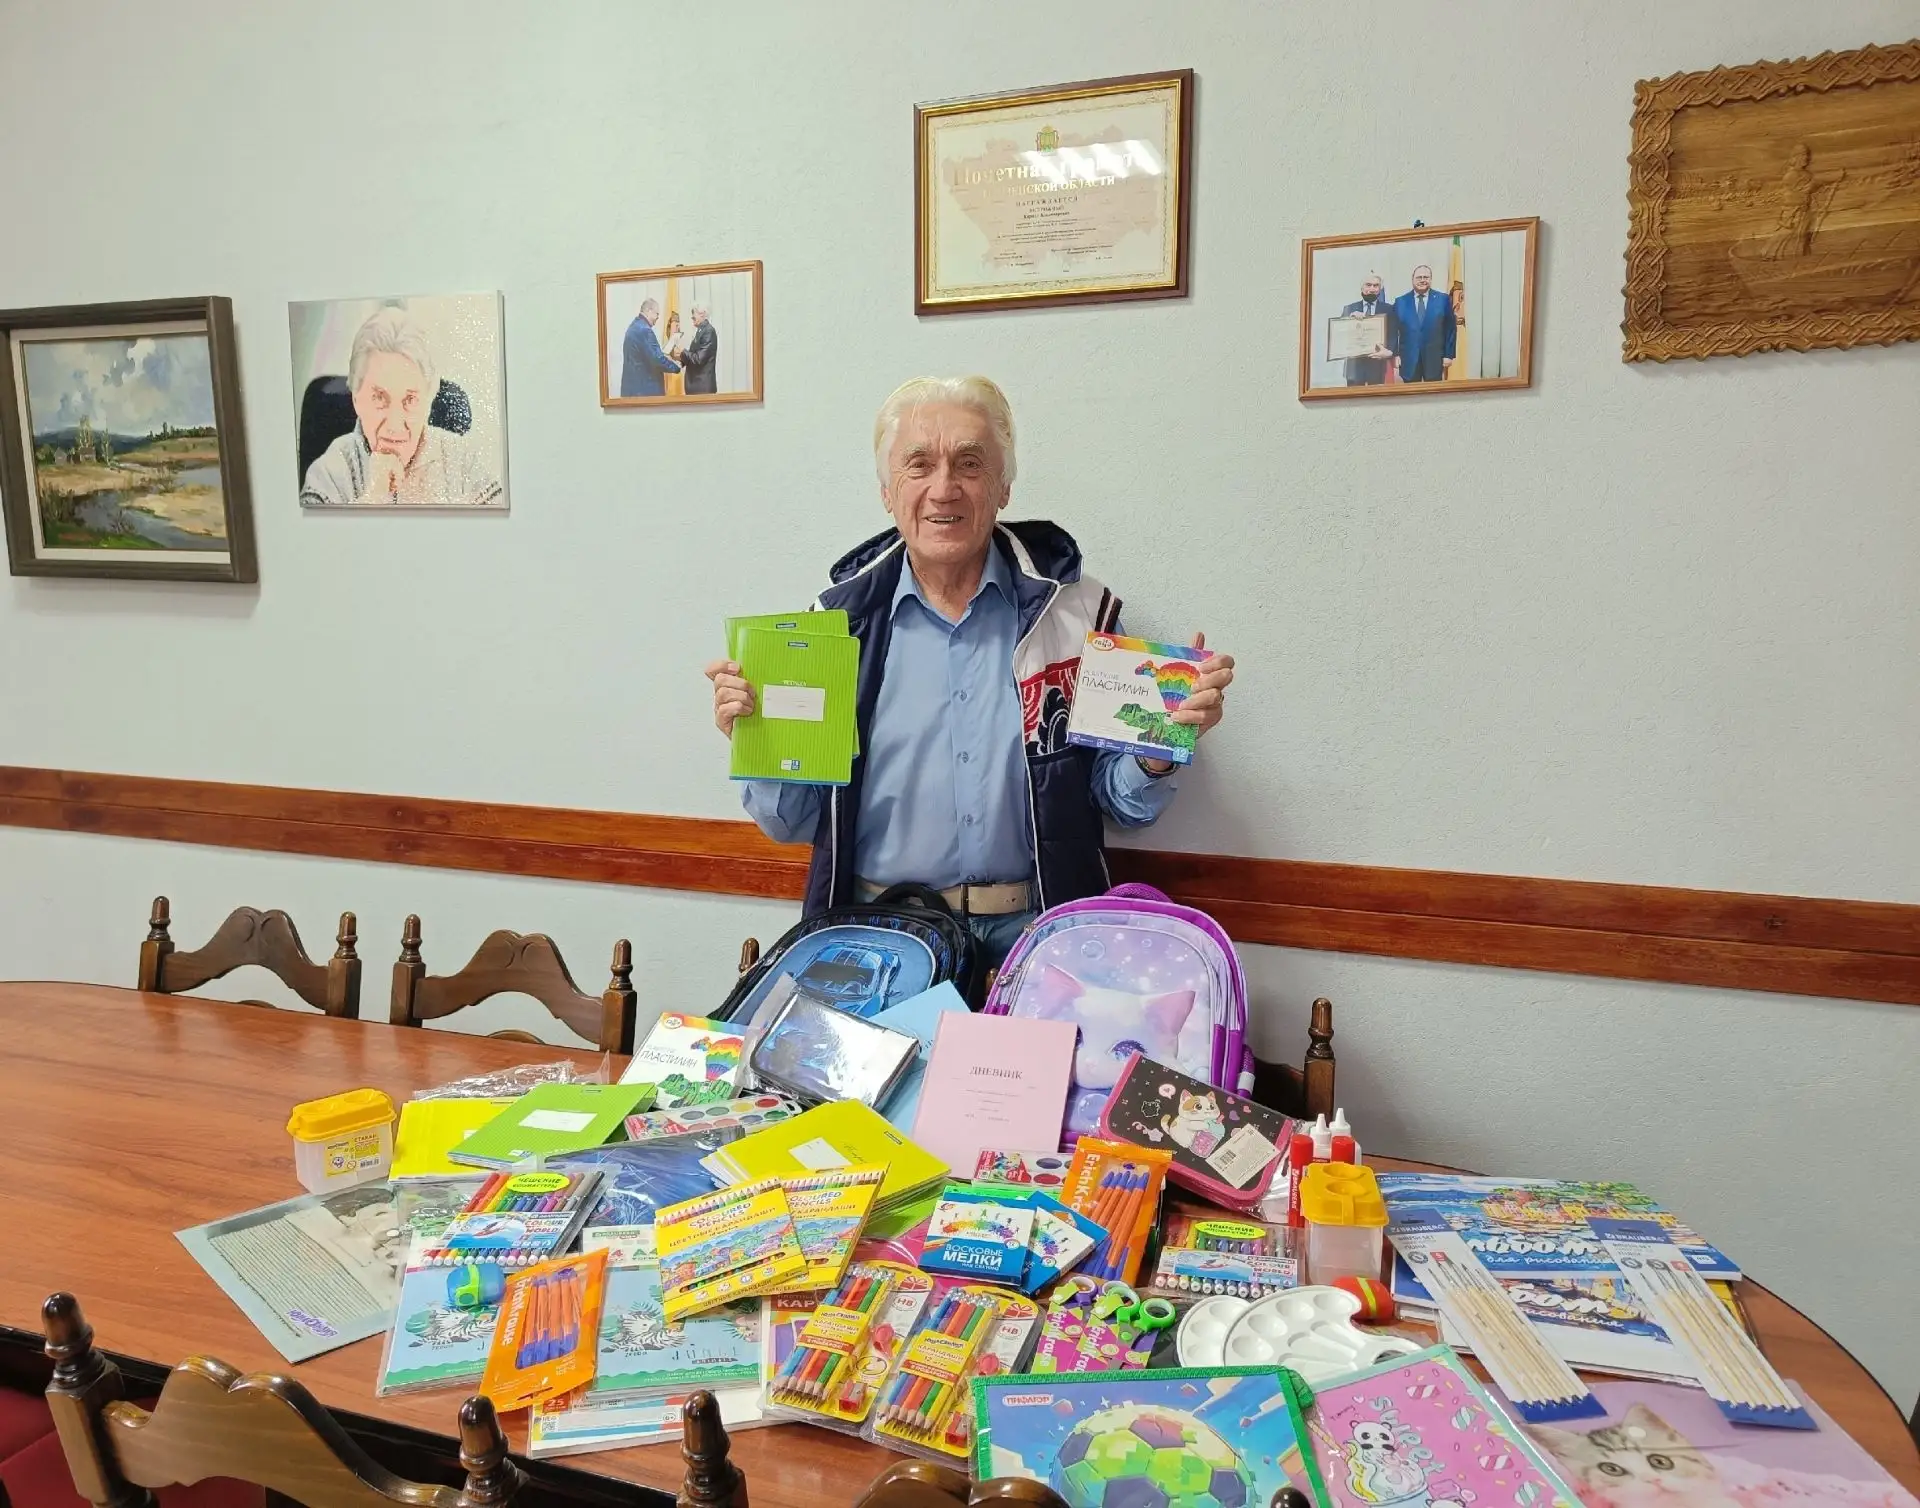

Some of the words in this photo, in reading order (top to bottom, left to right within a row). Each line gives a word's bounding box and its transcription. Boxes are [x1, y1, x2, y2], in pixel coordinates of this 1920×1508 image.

[1061, 175, 1115, 191] ОБЛАСТИ
[1082, 676, 1150, 697] ПЛАСТИЛИН
[1175, 748, 1187, 758] 12
[639, 1050, 698, 1068] ПЛАСТИЛИН
[969, 1065, 1023, 1080] ДНЕВНИК
[1070, 1153, 1101, 1213] ErichKra
[789, 1191, 842, 1201] OLOURED
[689, 1202, 751, 1228] COLOURED
[1466, 1233, 1600, 1256] льбом
[1614, 1233, 1664, 1242] BRAUBERG
[945, 1243, 1004, 1257] ВОСКОВЫЕ
[942, 1250, 1003, 1268] МЕЛКИ
[1485, 1255, 1521, 1264] для
[1525, 1255, 1615, 1265] рисования
[777, 1299, 815, 1308] КАР
[897, 1297, 914, 1307] HB
[502, 1276, 532, 1347] ErichKrause
[1521, 1308, 1625, 1328] исования
[1002, 1326, 1019, 1335] HB
[1073, 1321, 1107, 1372] ErichKra
[547, 1399, 565, 1407] 25
[1006, 1396, 1050, 1404] ПИФАГОР
